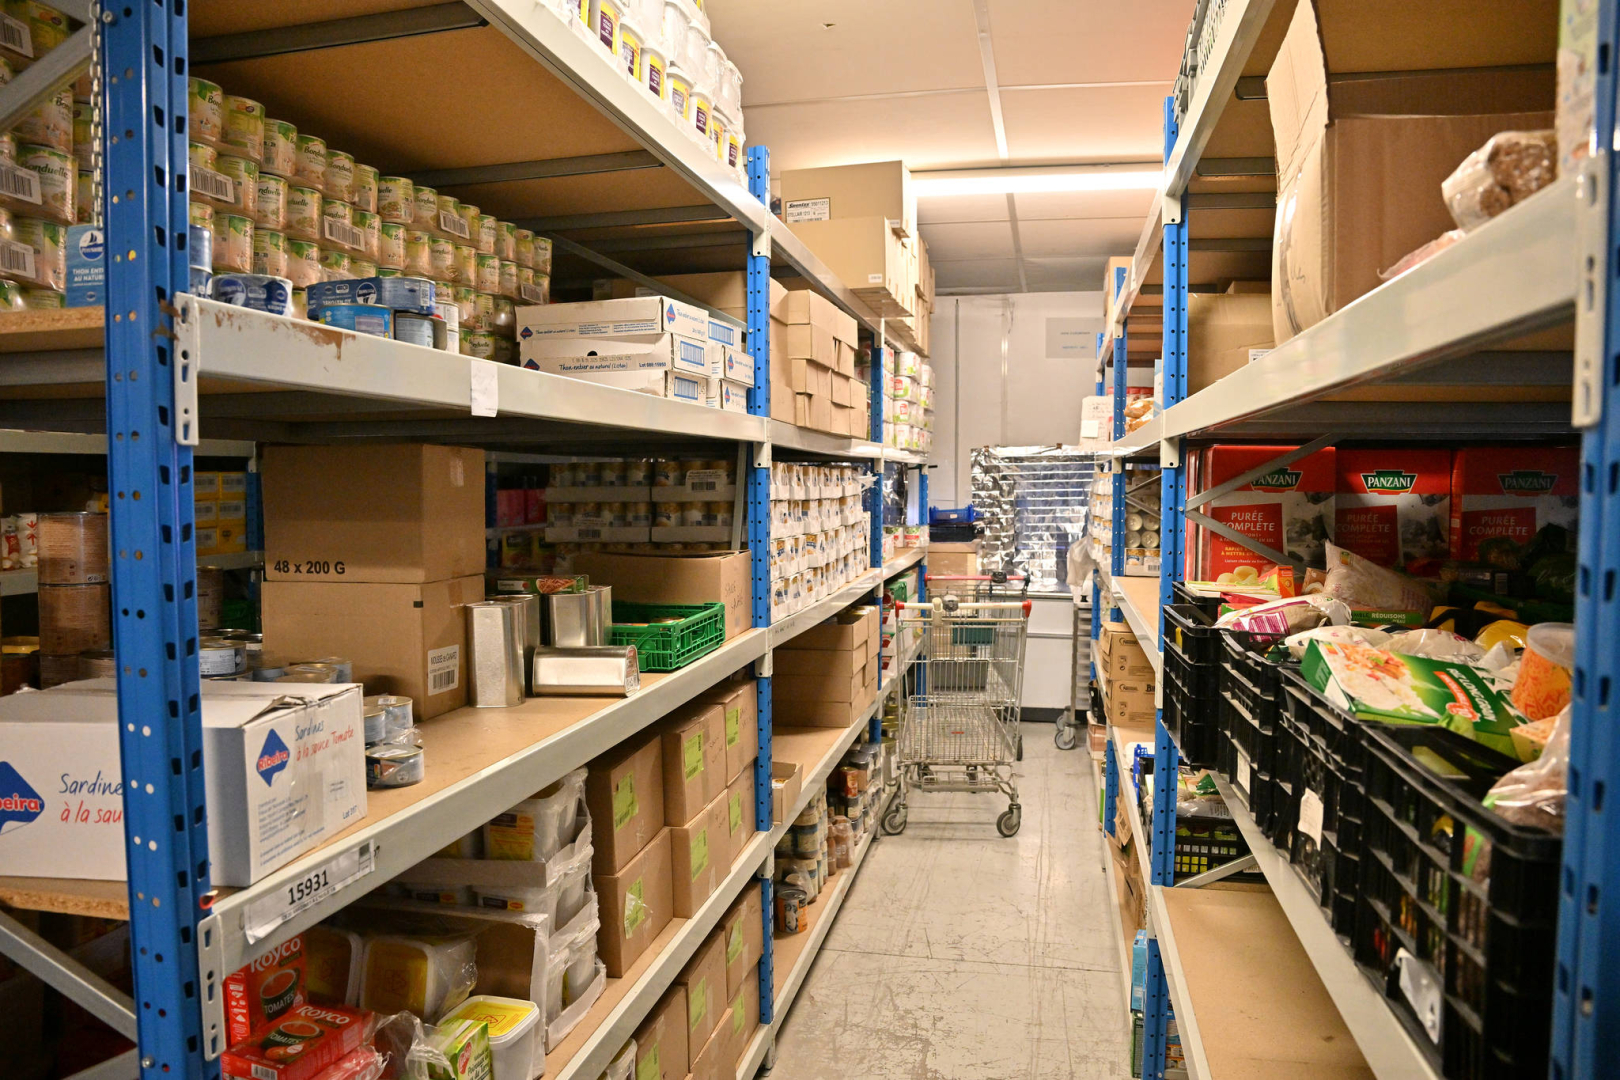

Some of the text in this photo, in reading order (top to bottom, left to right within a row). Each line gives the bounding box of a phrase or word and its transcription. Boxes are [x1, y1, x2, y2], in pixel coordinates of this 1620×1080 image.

[1367, 477, 1411, 488] PANZANI
[1505, 478, 1551, 488] PANZANI
[1231, 511, 1264, 521] PURÉE
[274, 560, 346, 575] 48 x 200 G
[1459, 679, 1484, 699] LONG
[295, 717, 324, 741] Sardines
[310, 739, 330, 756] sauce
[331, 725, 354, 744] Tomate
[258, 750, 288, 772] Ribeira
[59, 770, 123, 796] Sardine
[0, 793, 40, 812] eira
[60, 800, 122, 824] à la sau
[287, 869, 329, 906] 15931
[264, 992, 294, 1014] TOMATES
[296, 1006, 350, 1024] ROYCO
[267, 1032, 302, 1045] TOMATES
